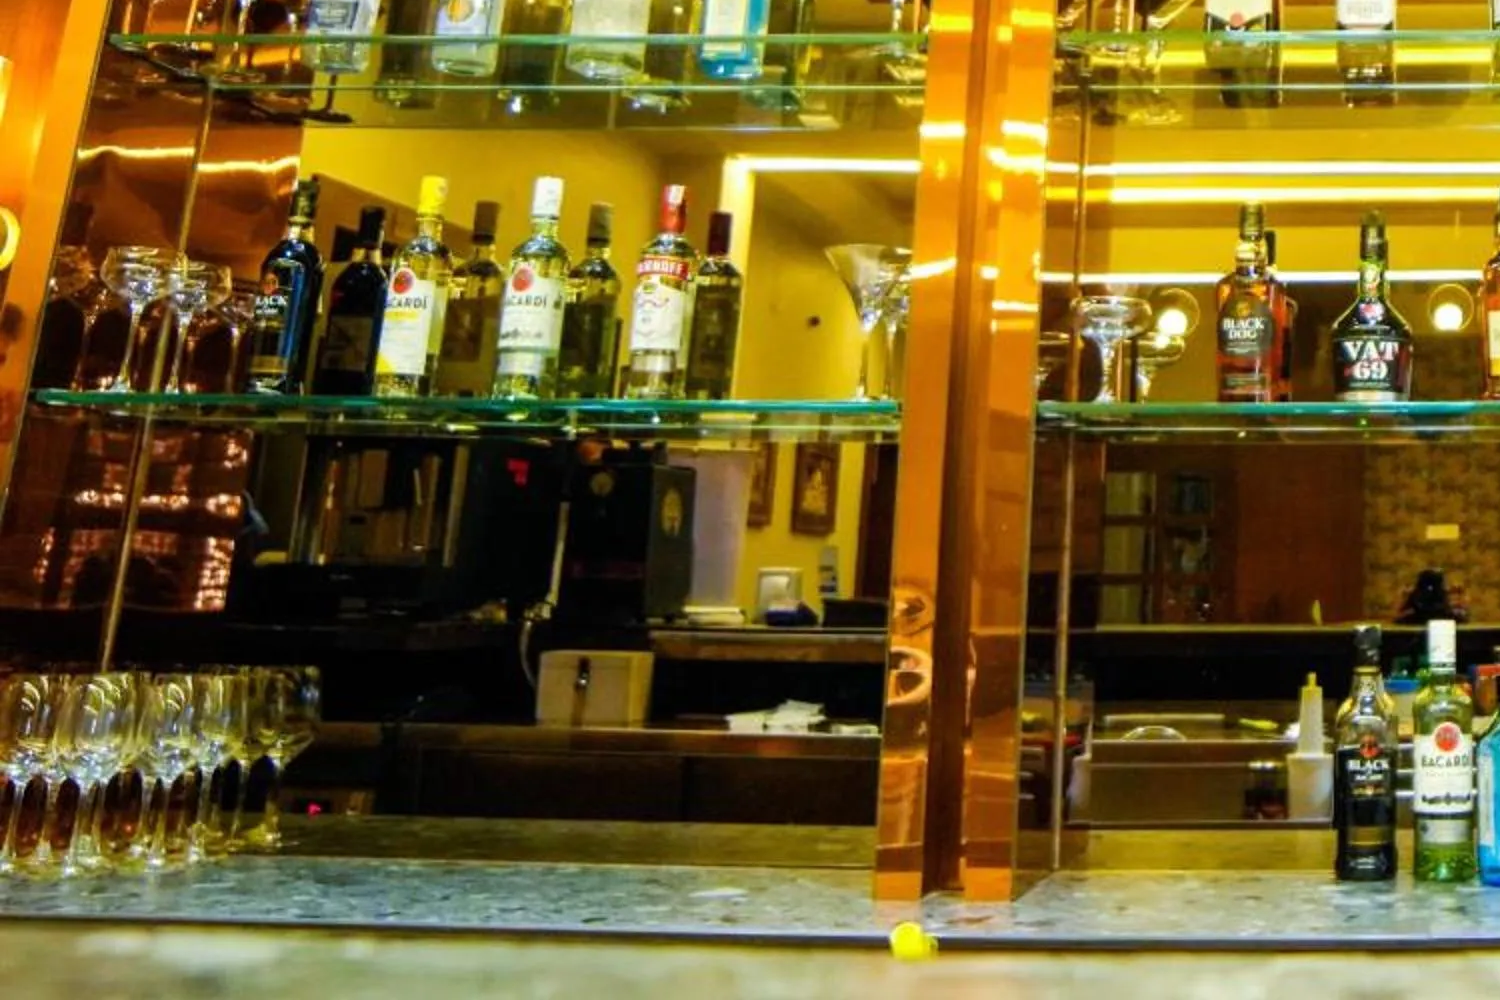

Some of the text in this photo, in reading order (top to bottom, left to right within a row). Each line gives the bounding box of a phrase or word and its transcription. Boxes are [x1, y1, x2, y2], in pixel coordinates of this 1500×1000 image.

[1223, 317, 1265, 330] BLACK
[1229, 328, 1258, 340] DOG
[1342, 340, 1399, 361] VAT
[1352, 360, 1388, 379] 69
[1347, 758, 1389, 771] BLACK
[1420, 754, 1470, 768] BACARD
